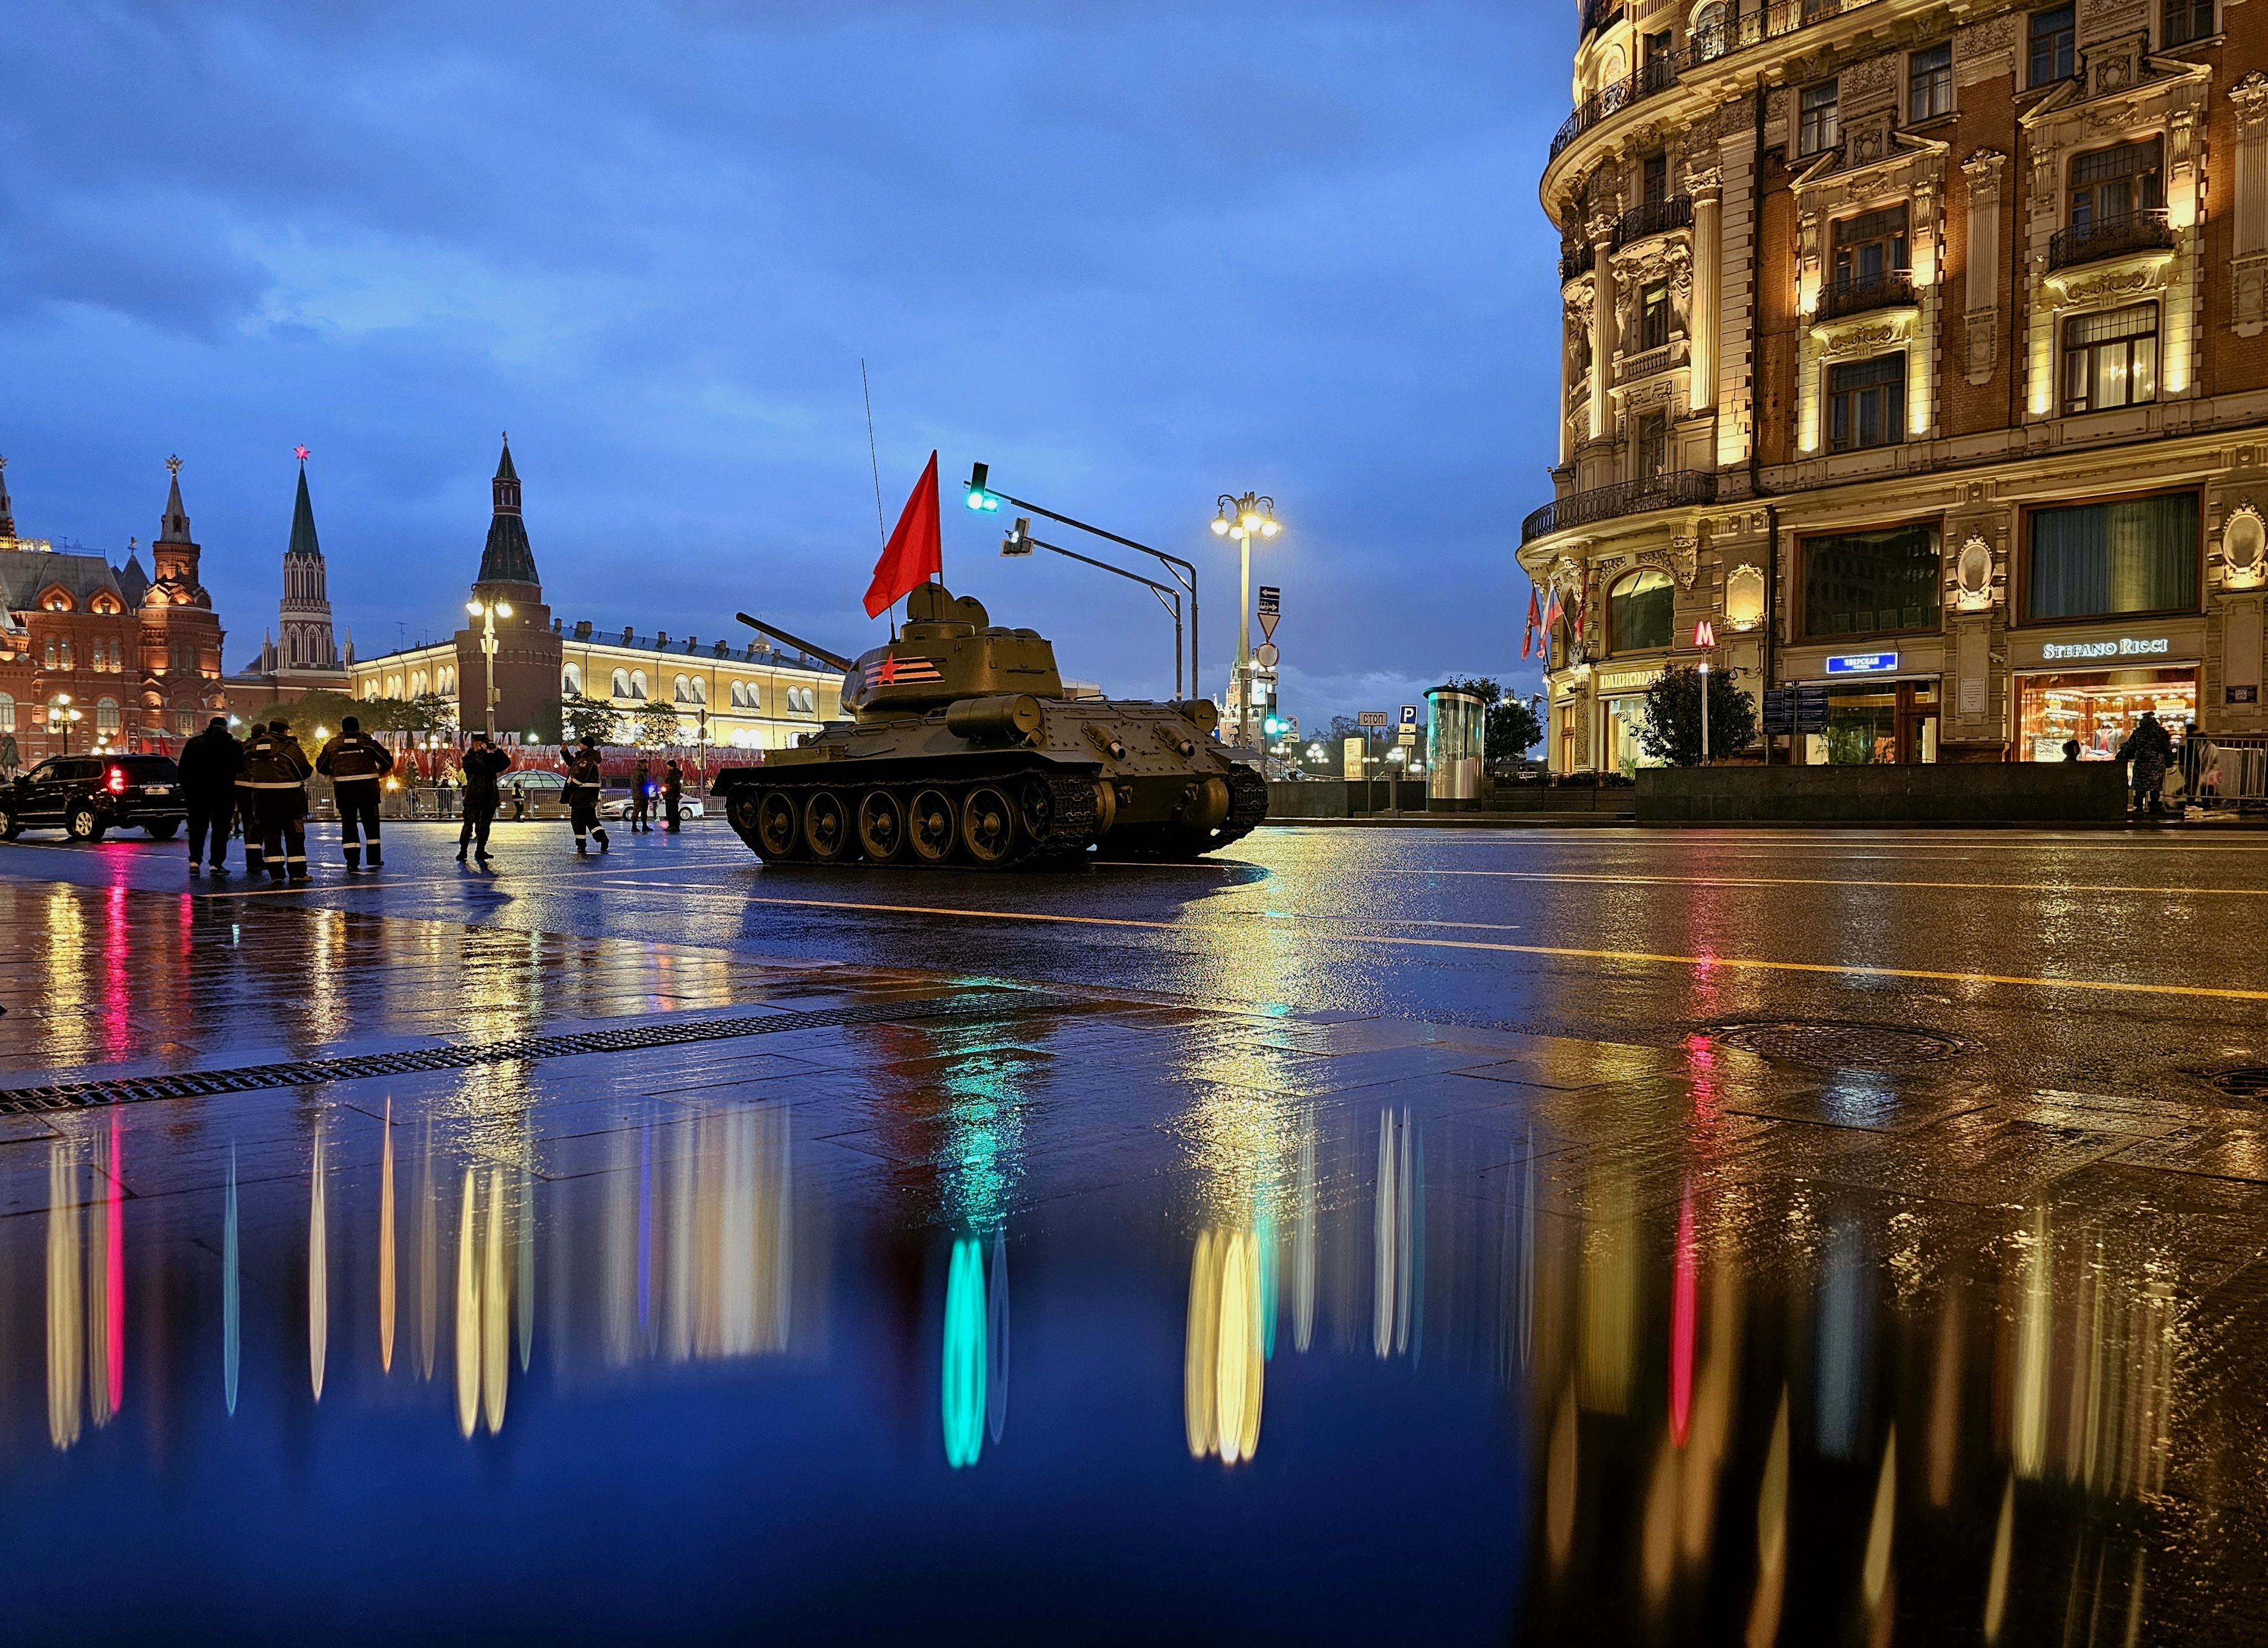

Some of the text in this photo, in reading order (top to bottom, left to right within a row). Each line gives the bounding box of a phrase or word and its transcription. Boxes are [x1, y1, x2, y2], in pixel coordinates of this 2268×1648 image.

[1694, 621, 1716, 646] М
[2043, 638, 2168, 659] STEFANO RICCI
[1363, 714, 1383, 724] СТОП
[1404, 707, 1414, 723] P
